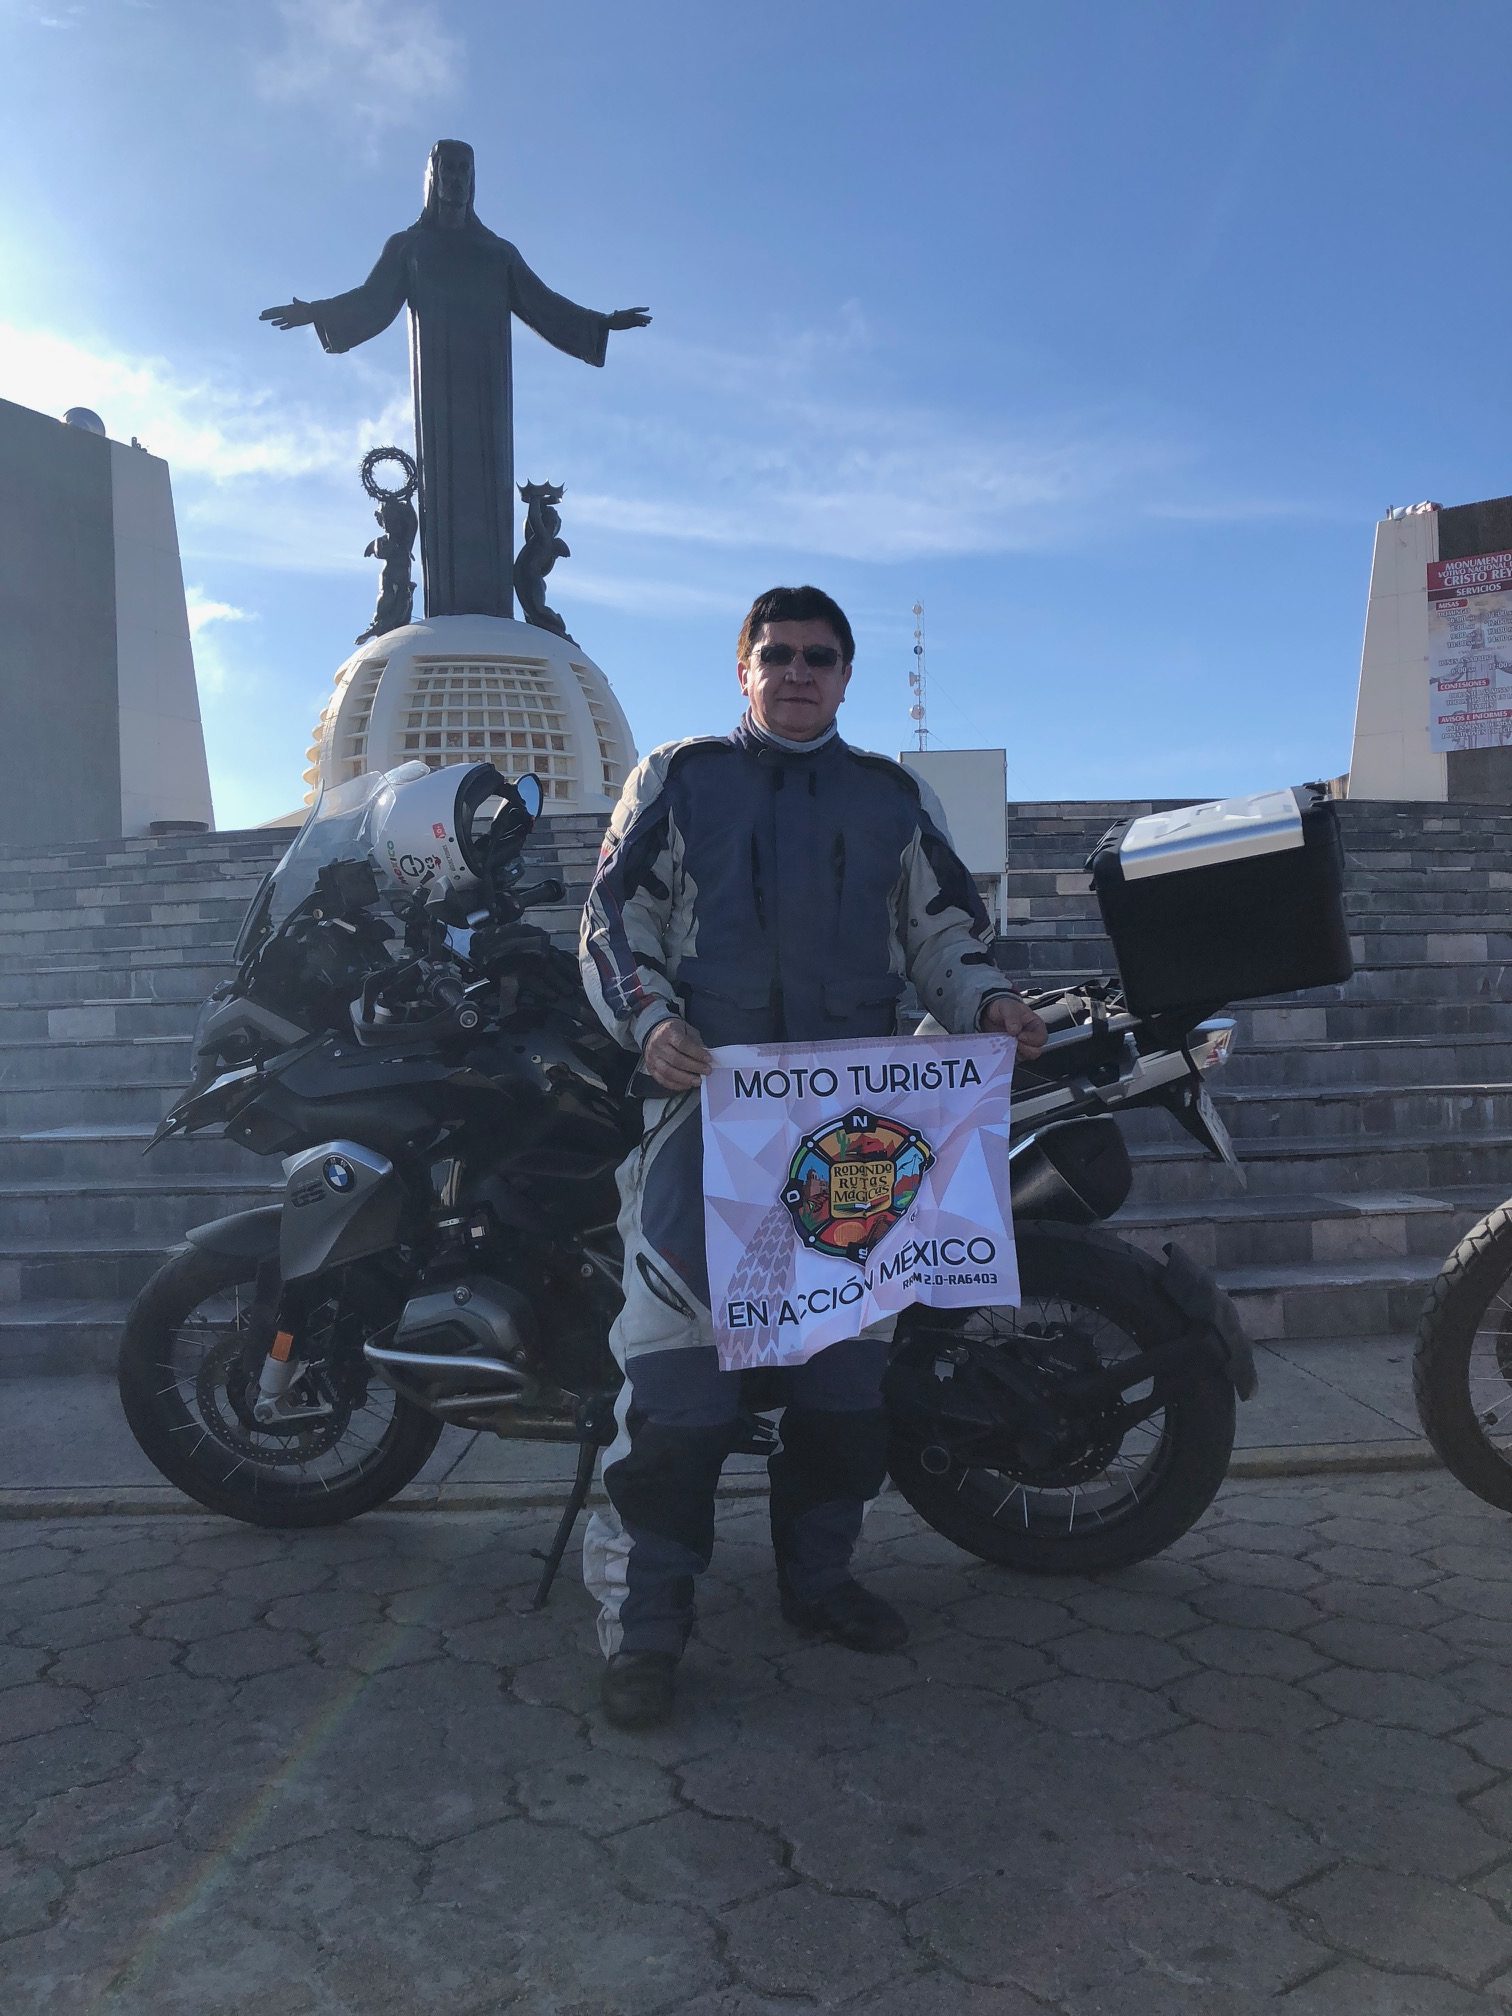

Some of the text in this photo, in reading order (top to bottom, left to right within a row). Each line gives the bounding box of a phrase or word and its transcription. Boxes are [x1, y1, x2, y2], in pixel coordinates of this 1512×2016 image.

[1445, 553, 1512, 571] MONUMENTO
[1438, 562, 1506, 578] VOTIVO NACIONAL
[1444, 567, 1512, 587] CRISTO REY
[1456, 582, 1502, 597] SERVICIOS
[1438, 600, 1460, 609] MISAS
[1440, 679, 1487, 690] CONFESIONES
[1441, 715, 1465, 723] AVISOS
[1472, 710, 1508, 720] INFORMES
[733, 1058, 982, 1098] MOTO TURISTA
[852, 1115, 868, 1127] N
[728, 1300, 769, 1328] EN
[879, 1236, 996, 1284] MÉXICO
[924, 1273, 998, 1286] 2.0-RA6403
